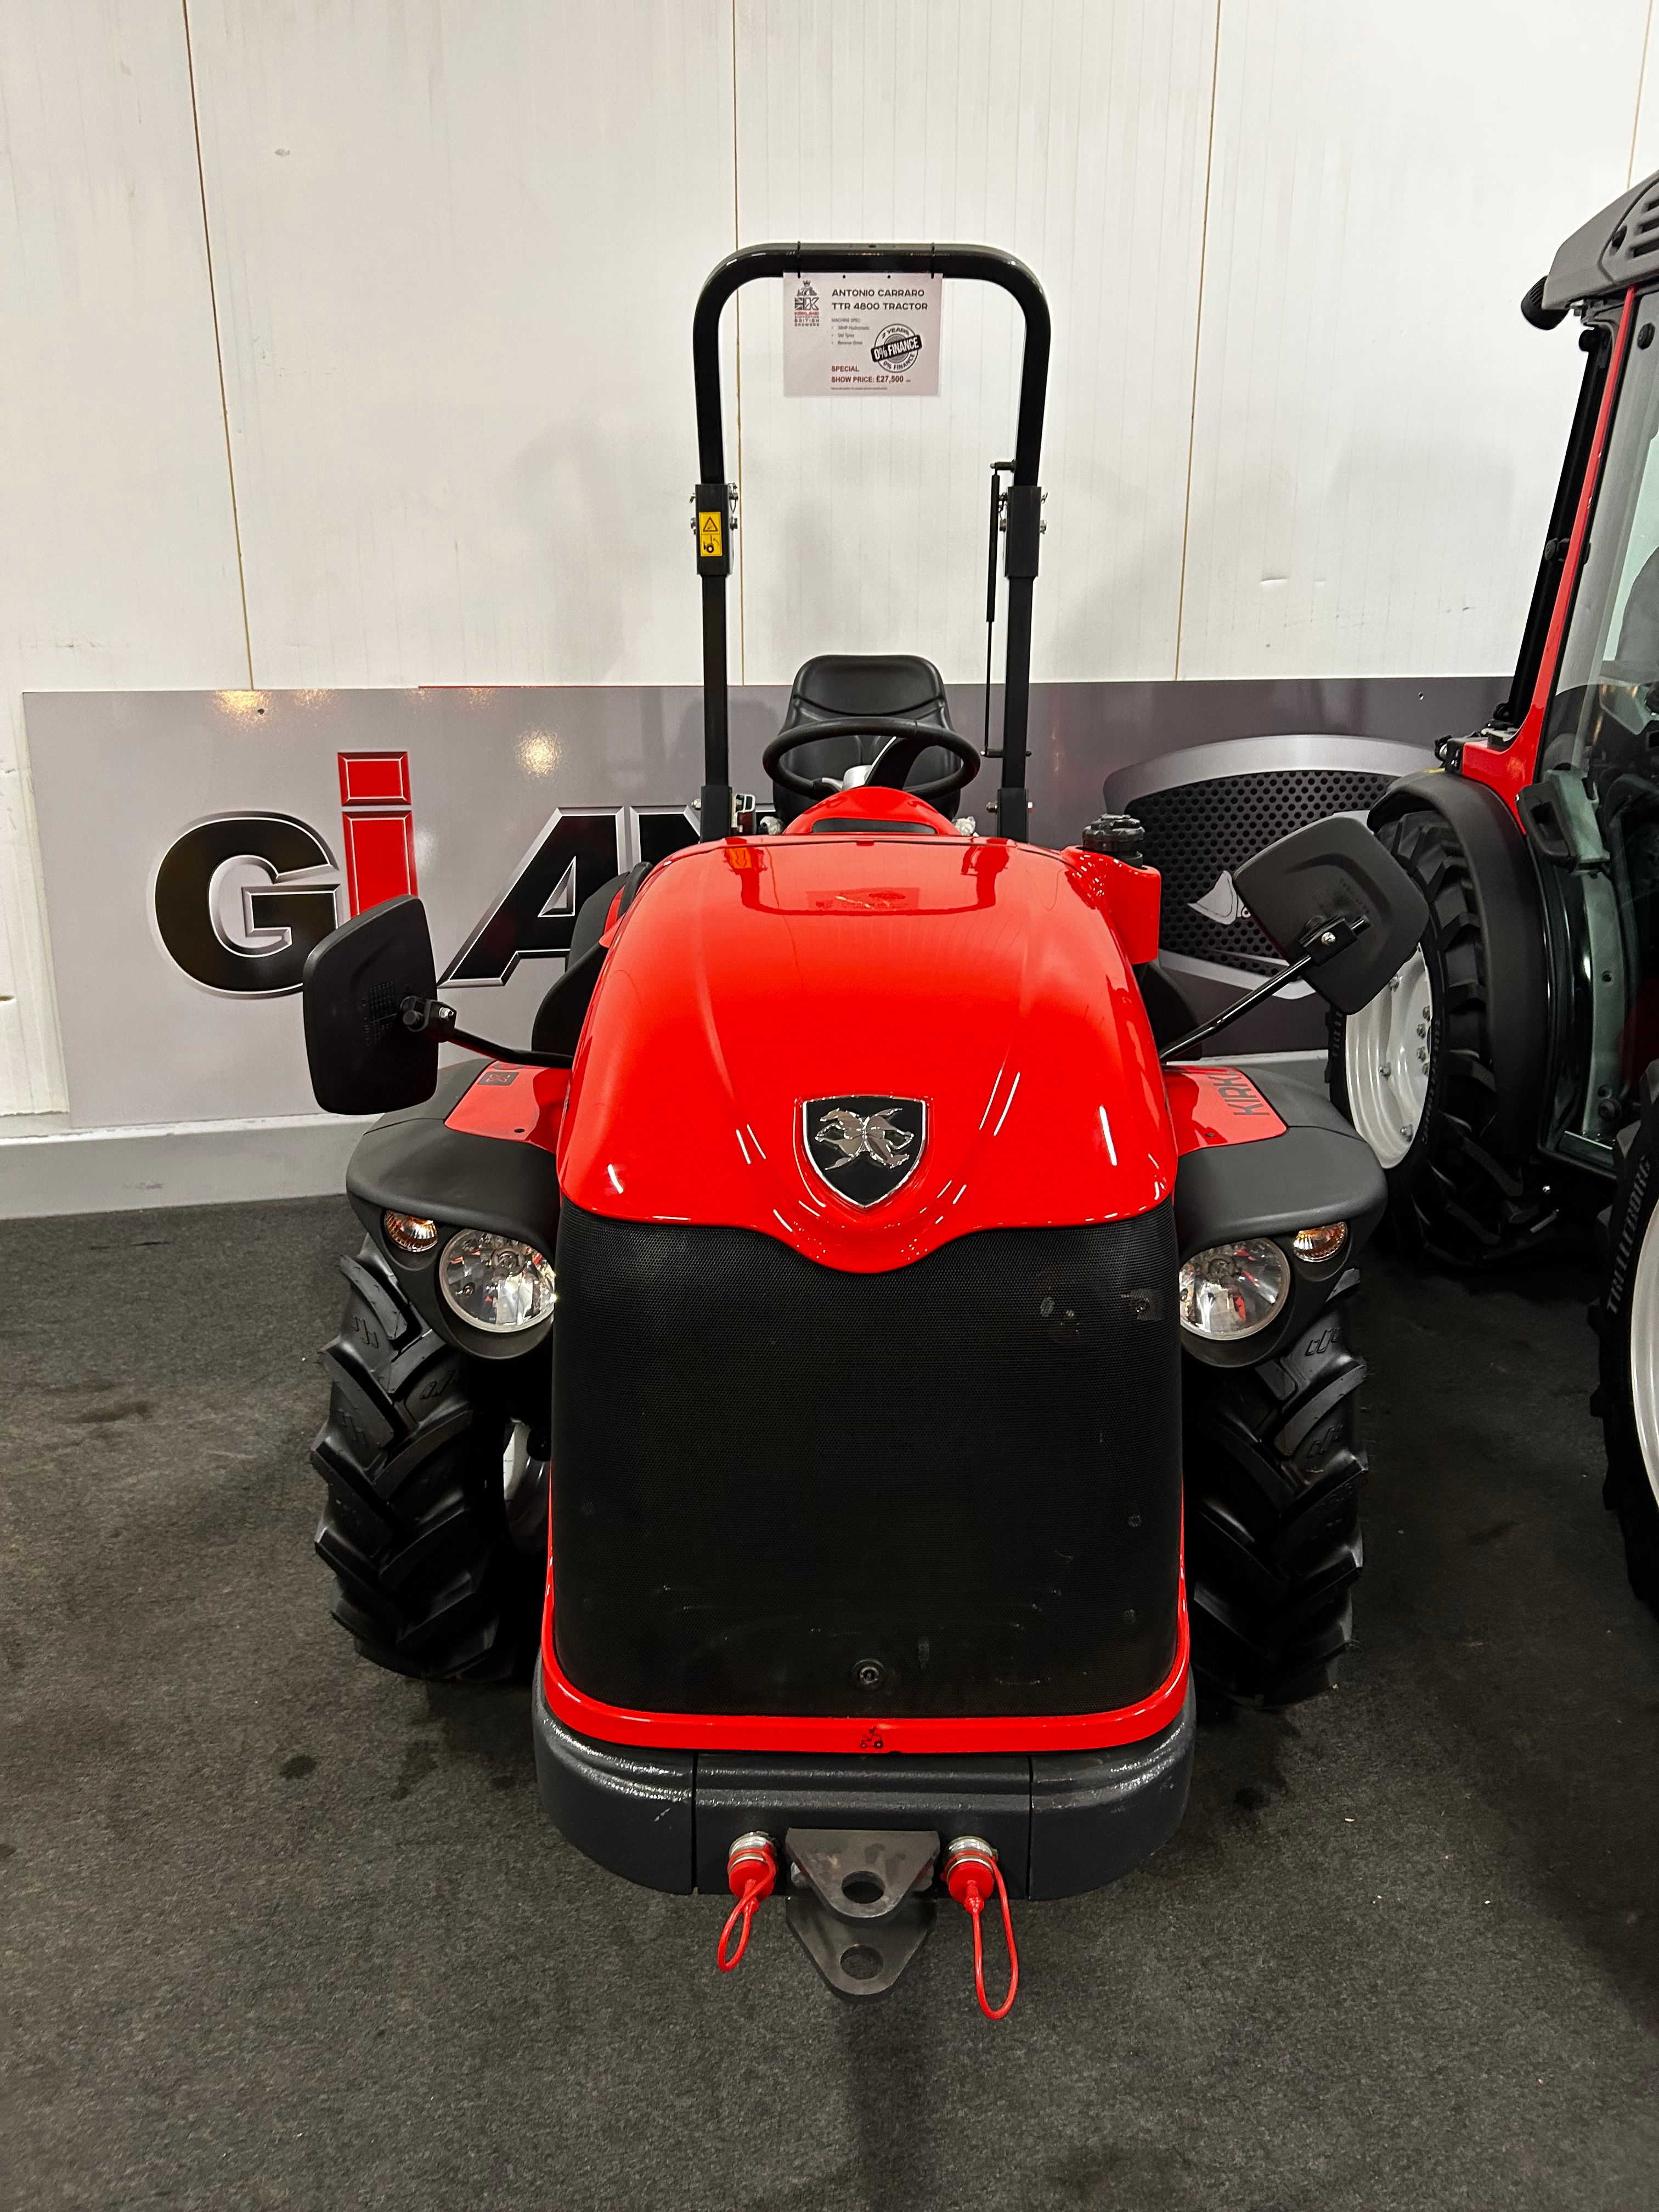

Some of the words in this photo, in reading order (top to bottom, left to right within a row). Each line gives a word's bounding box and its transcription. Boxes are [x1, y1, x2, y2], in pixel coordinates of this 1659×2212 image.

[832, 289, 875, 297] ANTONIO
[878, 289, 925, 297] CARRARO
[831, 302, 851, 311] TTR
[853, 302, 880, 311] 4800
[882, 302, 928, 311] TRACTOR
[873, 346, 888, 360] 0%
[887, 336, 919, 357] FINANCE
[883, 361, 892, 369] 0%
[893, 353, 915, 370] FINANCE
[876, 375, 904, 384] £27,500
[149, 752, 775, 1000] GiA
